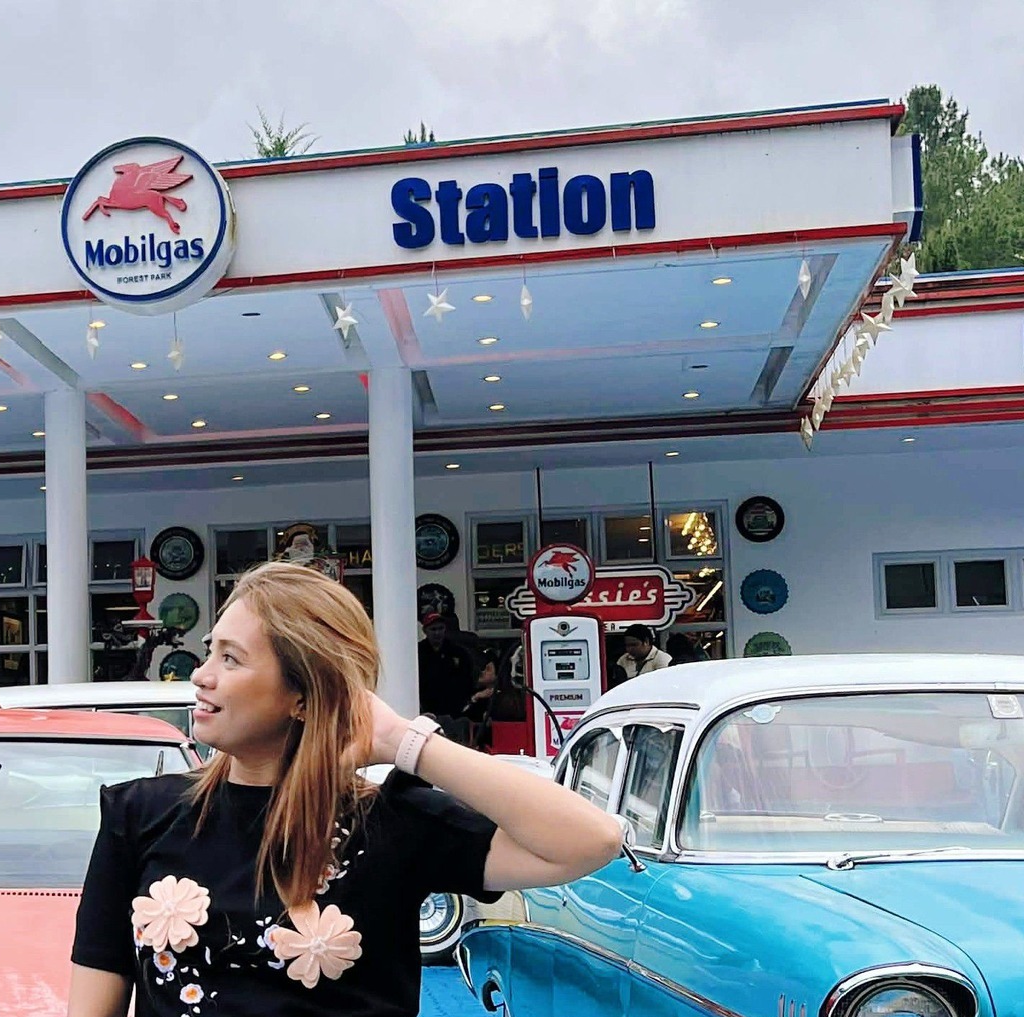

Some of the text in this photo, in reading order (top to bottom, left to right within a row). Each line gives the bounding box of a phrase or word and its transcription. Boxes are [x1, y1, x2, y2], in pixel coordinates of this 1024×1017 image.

[391, 166, 656, 249] Station
[85, 233, 204, 268] Mobilgas
[116, 272, 172, 284] FOREST PARK
[538, 577, 586, 589] Mobilgas
[549, 694, 583, 702] PREMIUM
